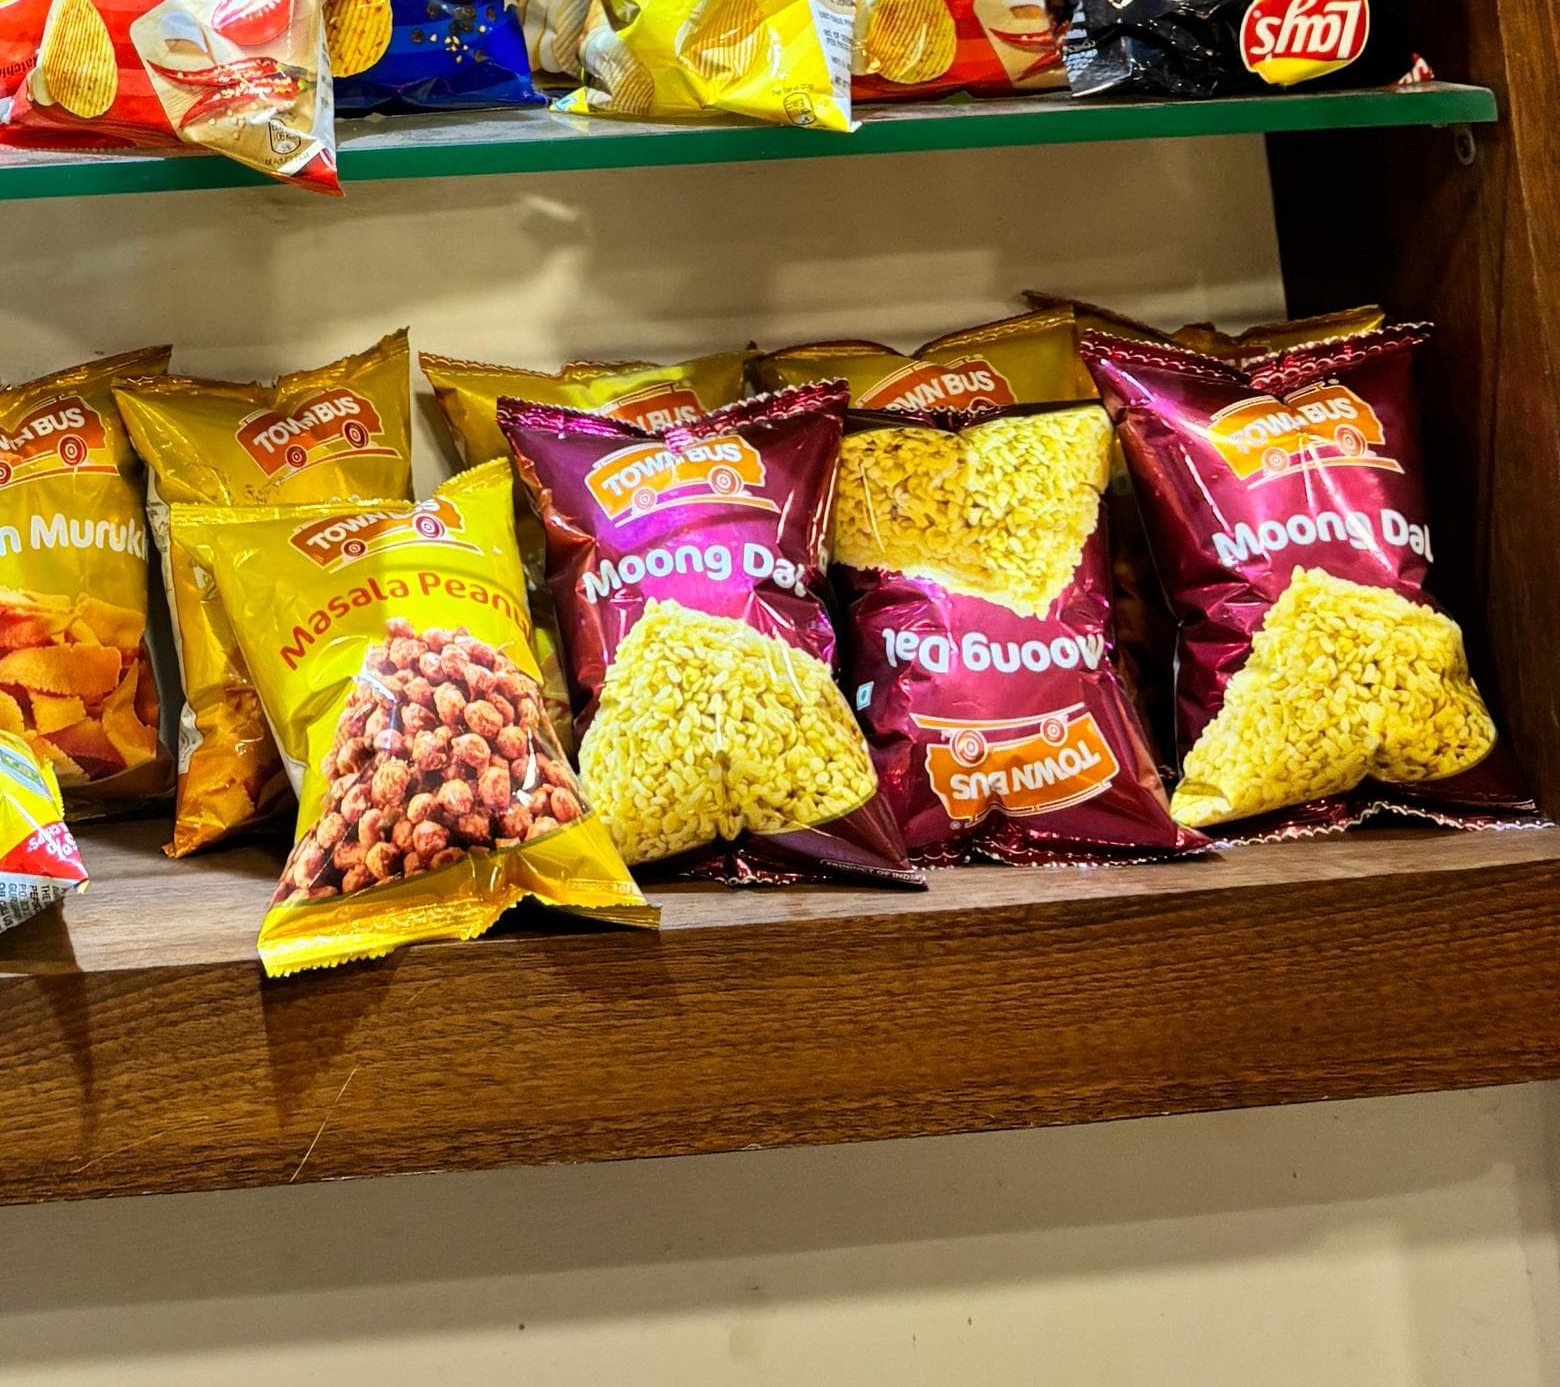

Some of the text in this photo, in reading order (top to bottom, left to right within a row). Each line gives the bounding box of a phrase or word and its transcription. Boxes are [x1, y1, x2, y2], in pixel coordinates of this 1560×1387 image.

[946, 369, 997, 395] BUS
[30, 406, 87, 439] BUS
[313, 394, 363, 426] BUS
[1306, 396, 1360, 425] BUS
[600, 440, 743, 497] TOWN BUS
[306, 509, 386, 552] TOWN
[1210, 507, 1435, 569] Moong Dal
[580, 543, 808, 606] Moong Dal
[279, 576, 411, 672] Masala
[881, 627, 1106, 674] Moong Dal
[949, 738, 1103, 802] TOWN BUS
